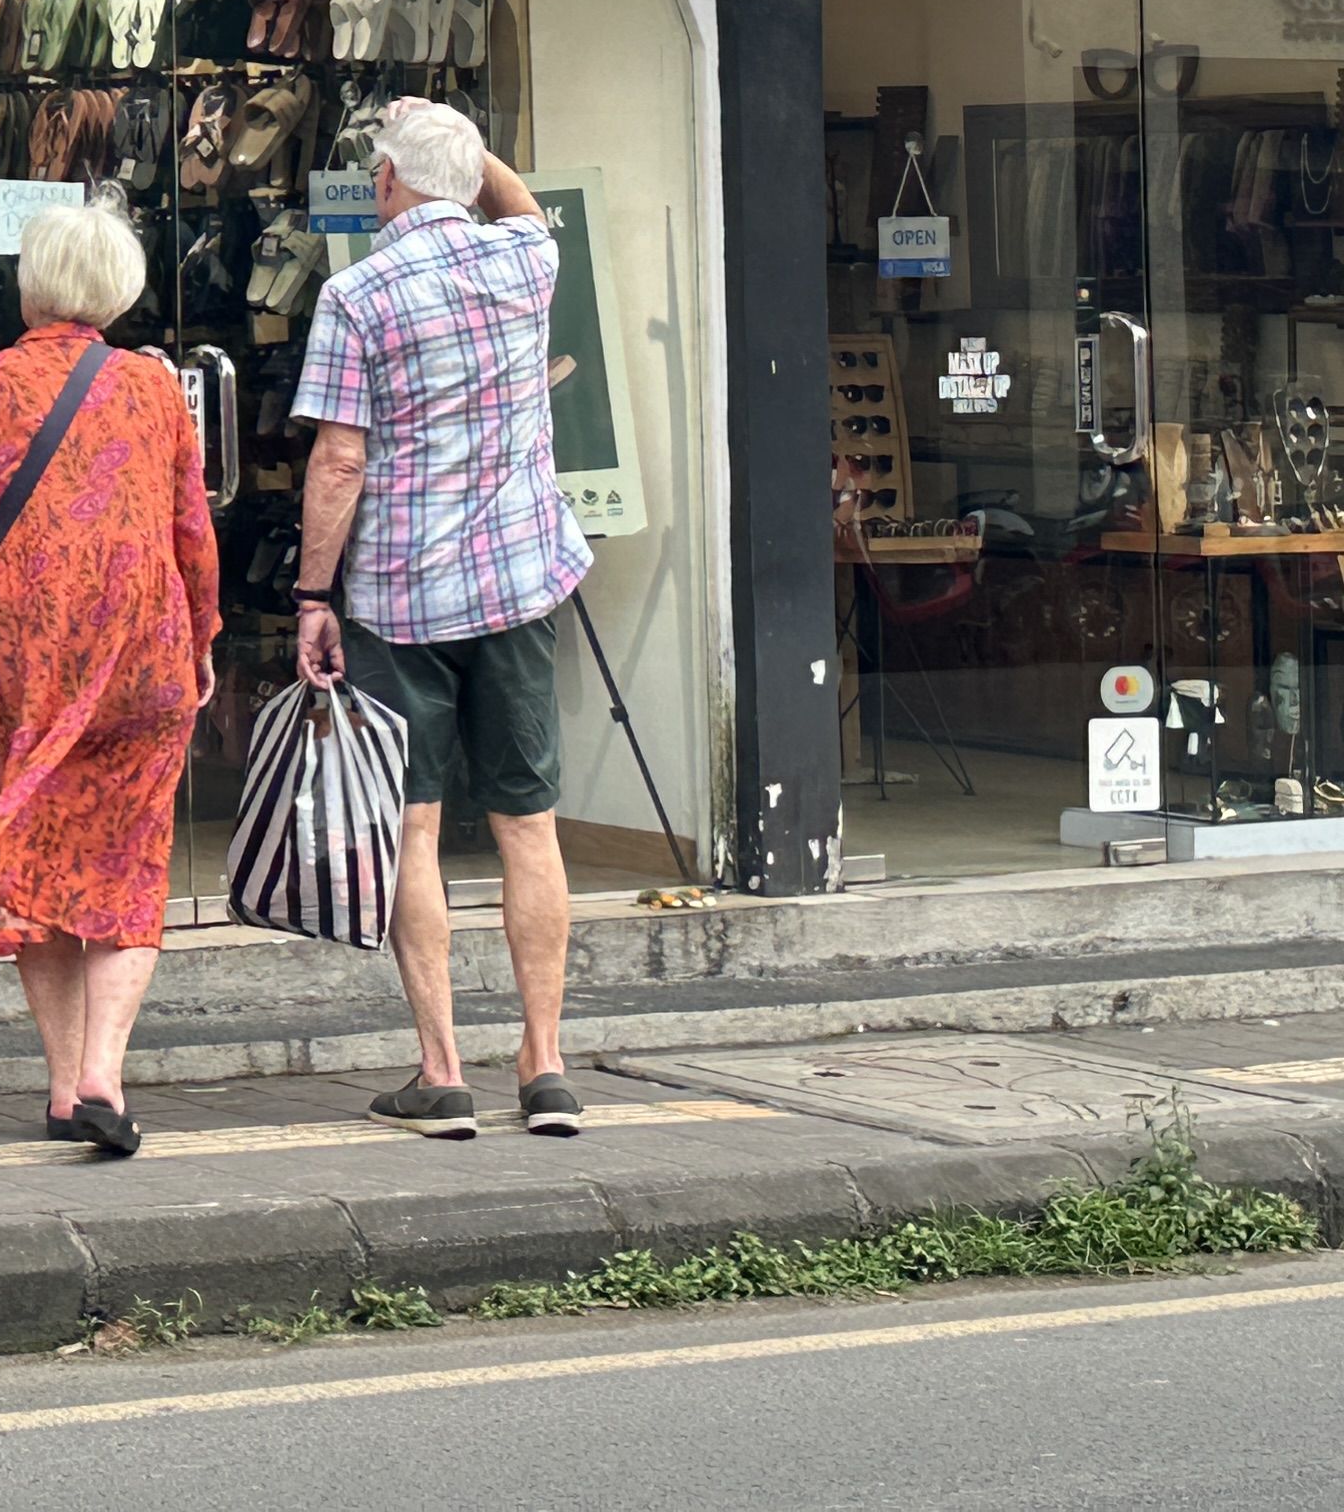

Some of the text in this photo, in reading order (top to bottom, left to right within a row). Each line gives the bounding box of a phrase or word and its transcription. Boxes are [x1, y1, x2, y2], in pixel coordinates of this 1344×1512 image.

[325, 184, 377, 201] OPEN
[892, 229, 937, 246] OPEN
[188, 374, 200, 442] PUS
